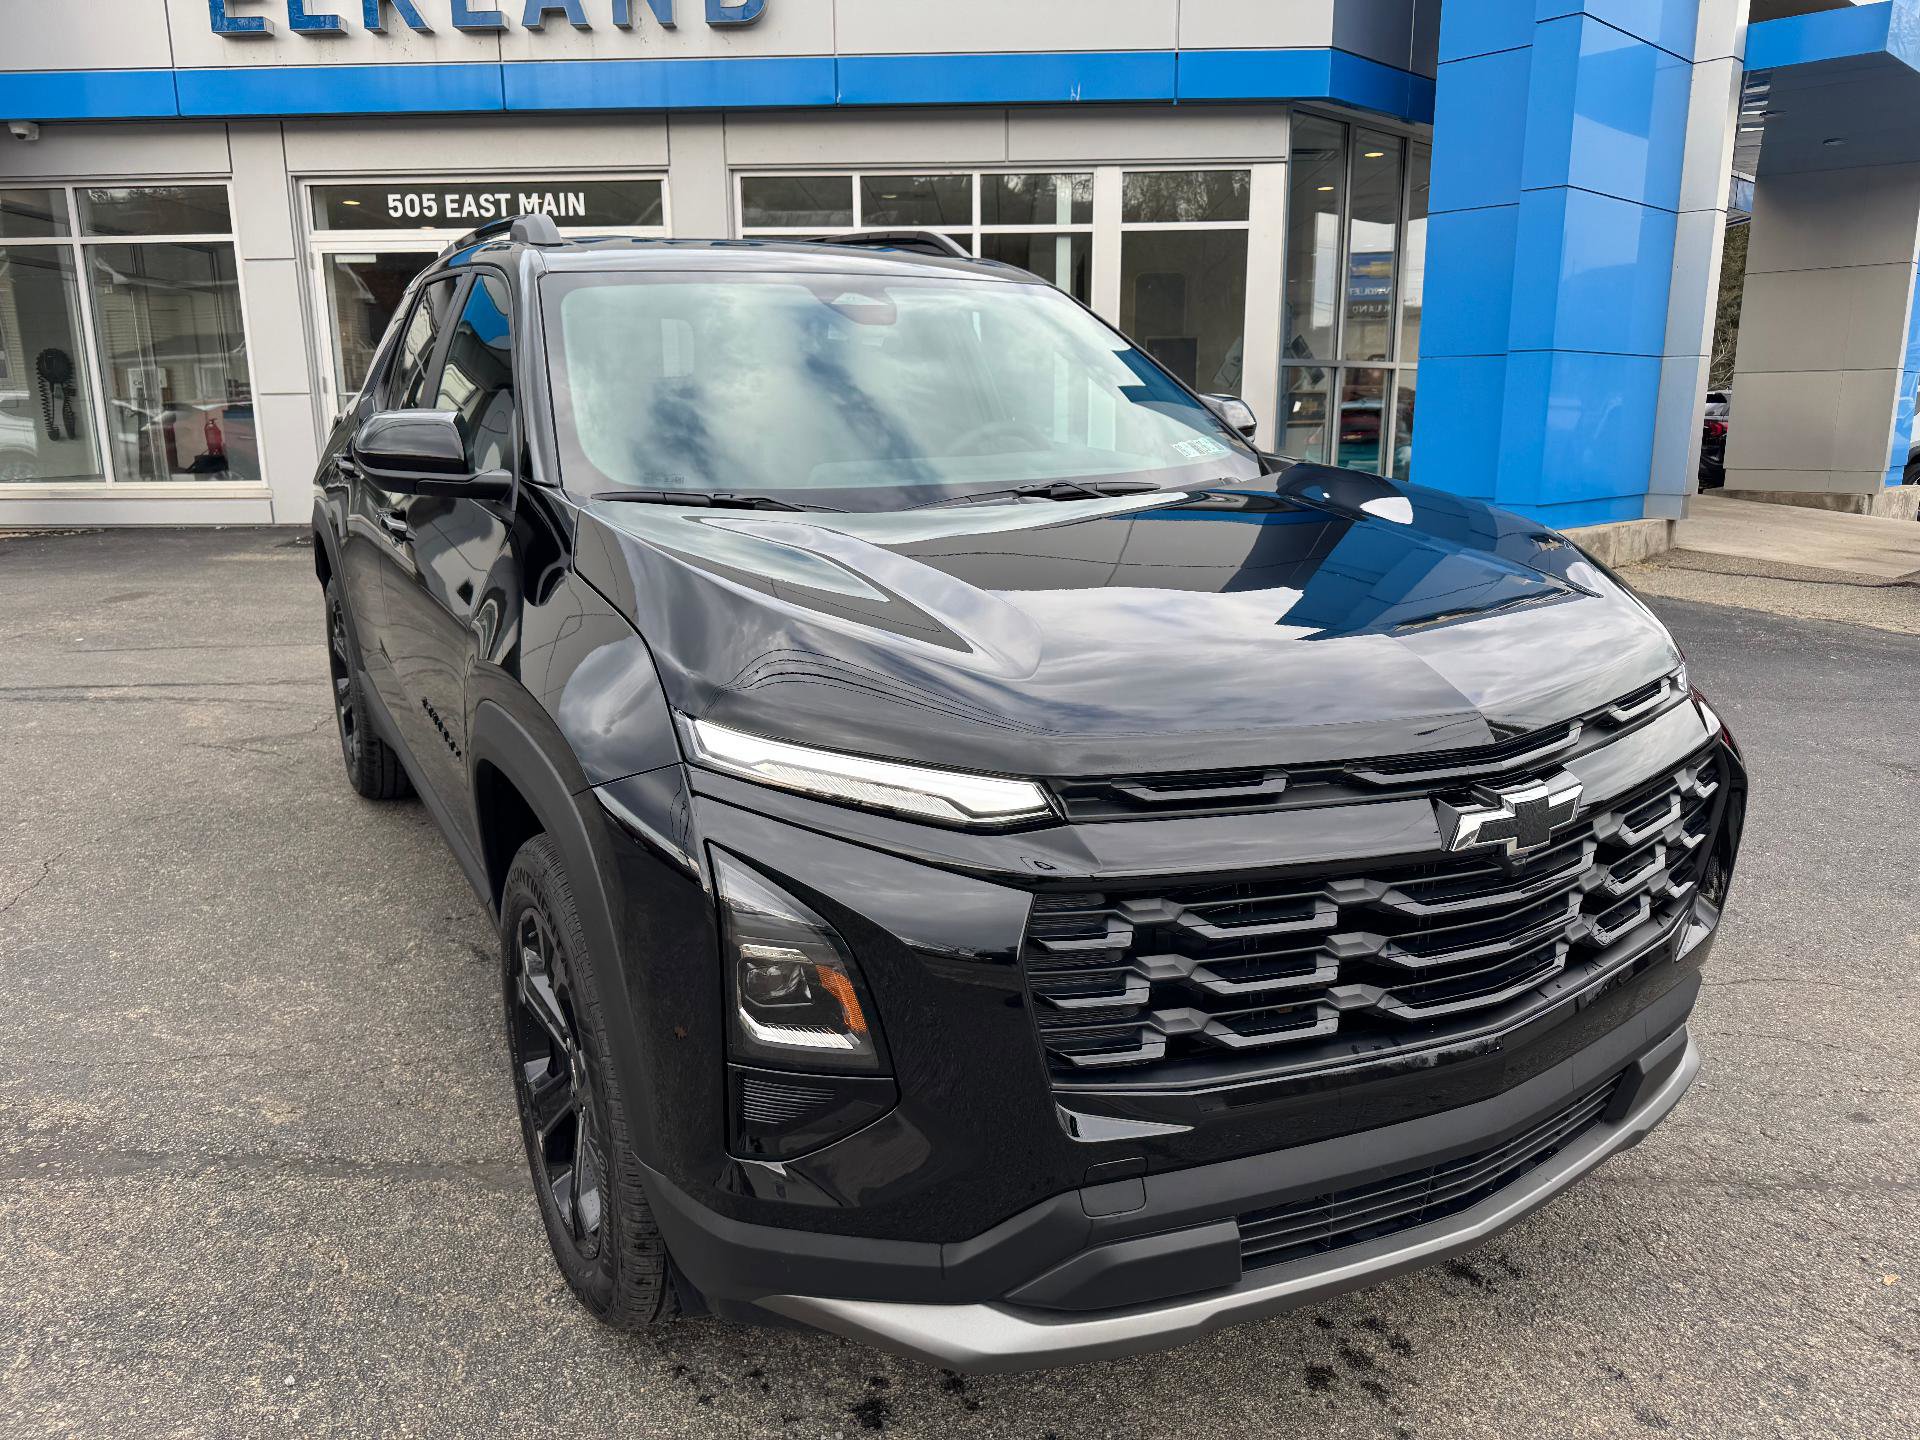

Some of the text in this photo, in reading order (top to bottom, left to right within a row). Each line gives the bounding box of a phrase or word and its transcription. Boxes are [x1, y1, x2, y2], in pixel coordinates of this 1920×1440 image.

[387, 192, 586, 218] 505 EAST MAIN
